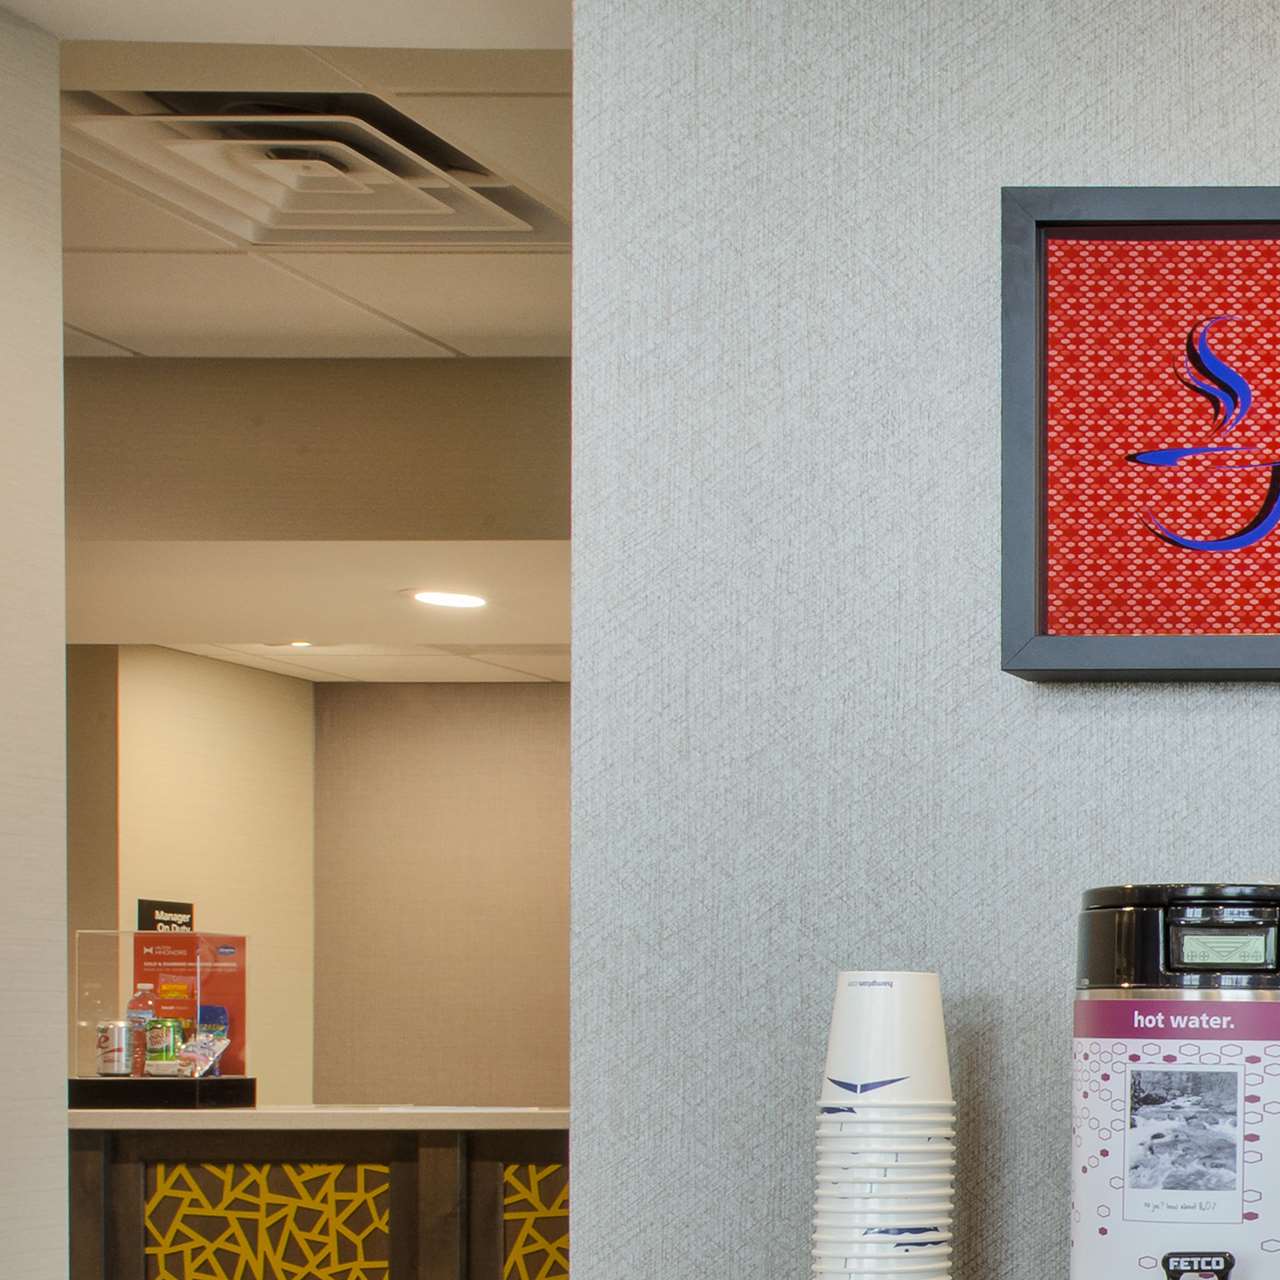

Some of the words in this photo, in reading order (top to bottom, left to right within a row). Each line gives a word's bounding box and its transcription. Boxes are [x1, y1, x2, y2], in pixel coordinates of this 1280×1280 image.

[154, 909, 191, 924] Manager
[1133, 1010, 1165, 1028] hot
[1170, 1012, 1235, 1029] water.
[1168, 1257, 1225, 1270] FETCO
